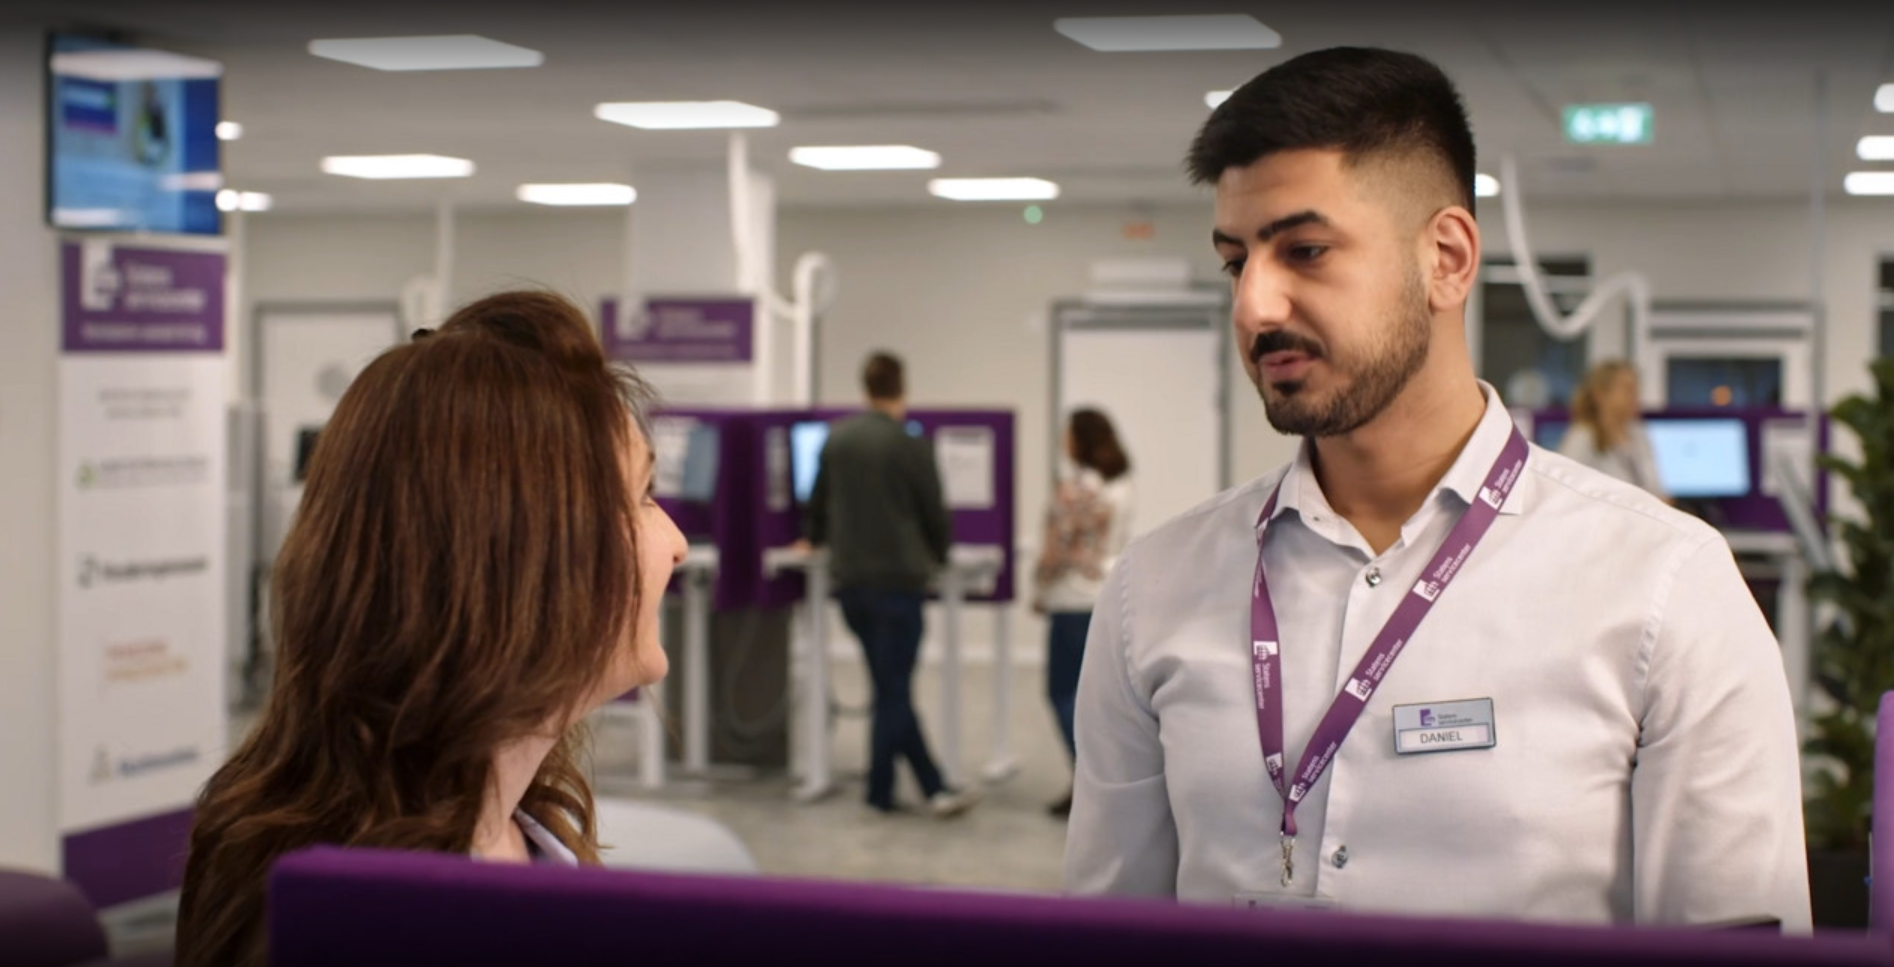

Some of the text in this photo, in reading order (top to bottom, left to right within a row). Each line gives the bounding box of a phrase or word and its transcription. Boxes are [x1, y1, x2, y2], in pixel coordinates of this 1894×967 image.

[1433, 556, 1453, 579] Statens
[1441, 542, 1471, 583] servicecenter
[1365, 652, 1385, 677] Statens
[1373, 638, 1403, 681] servicecenter
[1262, 663, 1270, 689] Statens
[1420, 731, 1463, 743] DANIEL
[1301, 755, 1319, 779] Statens
[1308, 741, 1337, 782] servicecenter
